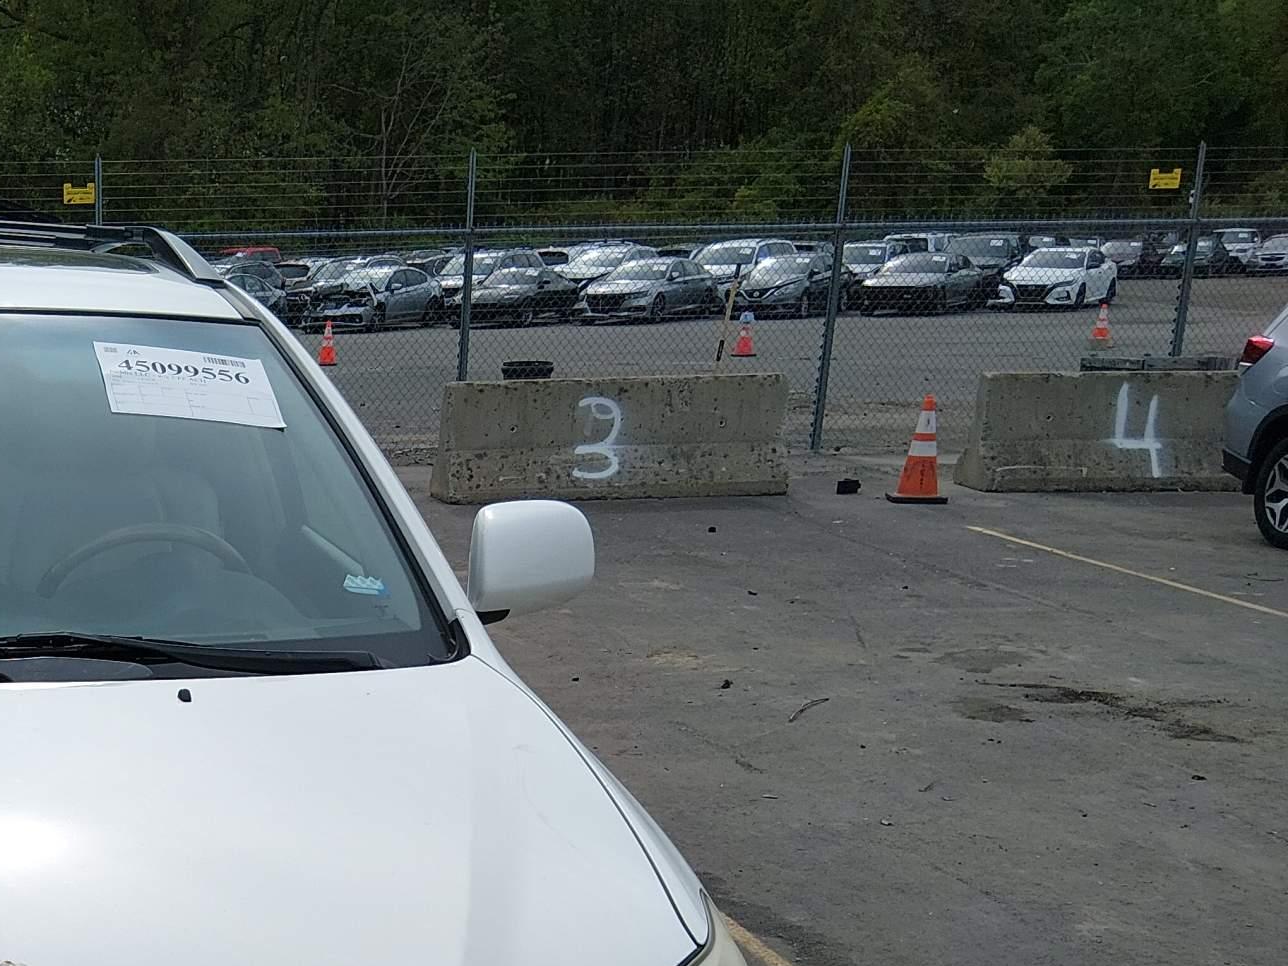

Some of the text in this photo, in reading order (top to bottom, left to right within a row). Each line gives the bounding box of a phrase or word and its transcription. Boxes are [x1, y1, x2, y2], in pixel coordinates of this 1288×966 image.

[117, 359, 250, 385] 45099556
[572, 396, 622, 480] 3
[1108, 379, 1164, 479] 4
